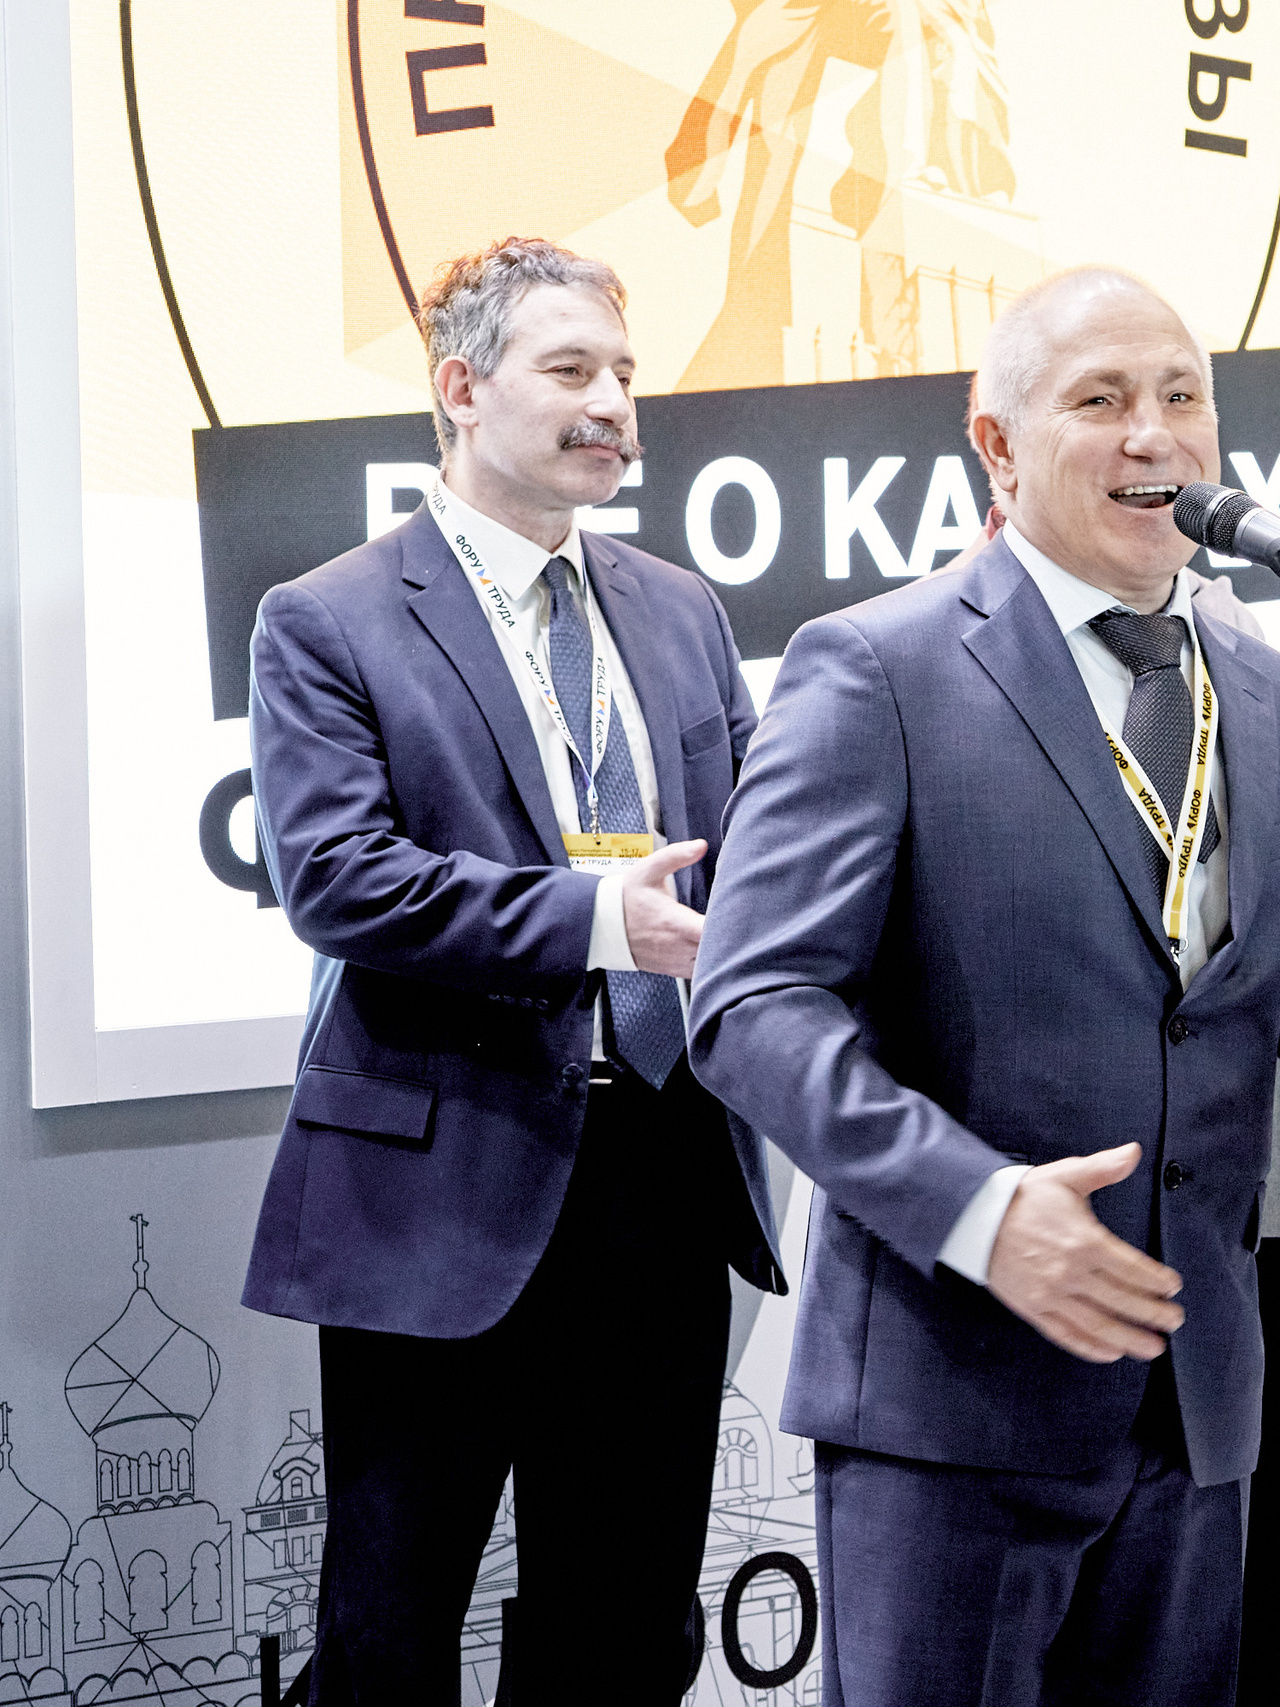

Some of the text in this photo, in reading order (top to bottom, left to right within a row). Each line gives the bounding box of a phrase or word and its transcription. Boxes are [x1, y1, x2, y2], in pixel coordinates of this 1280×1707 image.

[685, 456, 782, 586] О
[487, 585, 516, 628] ТРУДА
[1197, 729, 1209, 766] ТРУДА
[1138, 787, 1166, 829] ТРУДА
